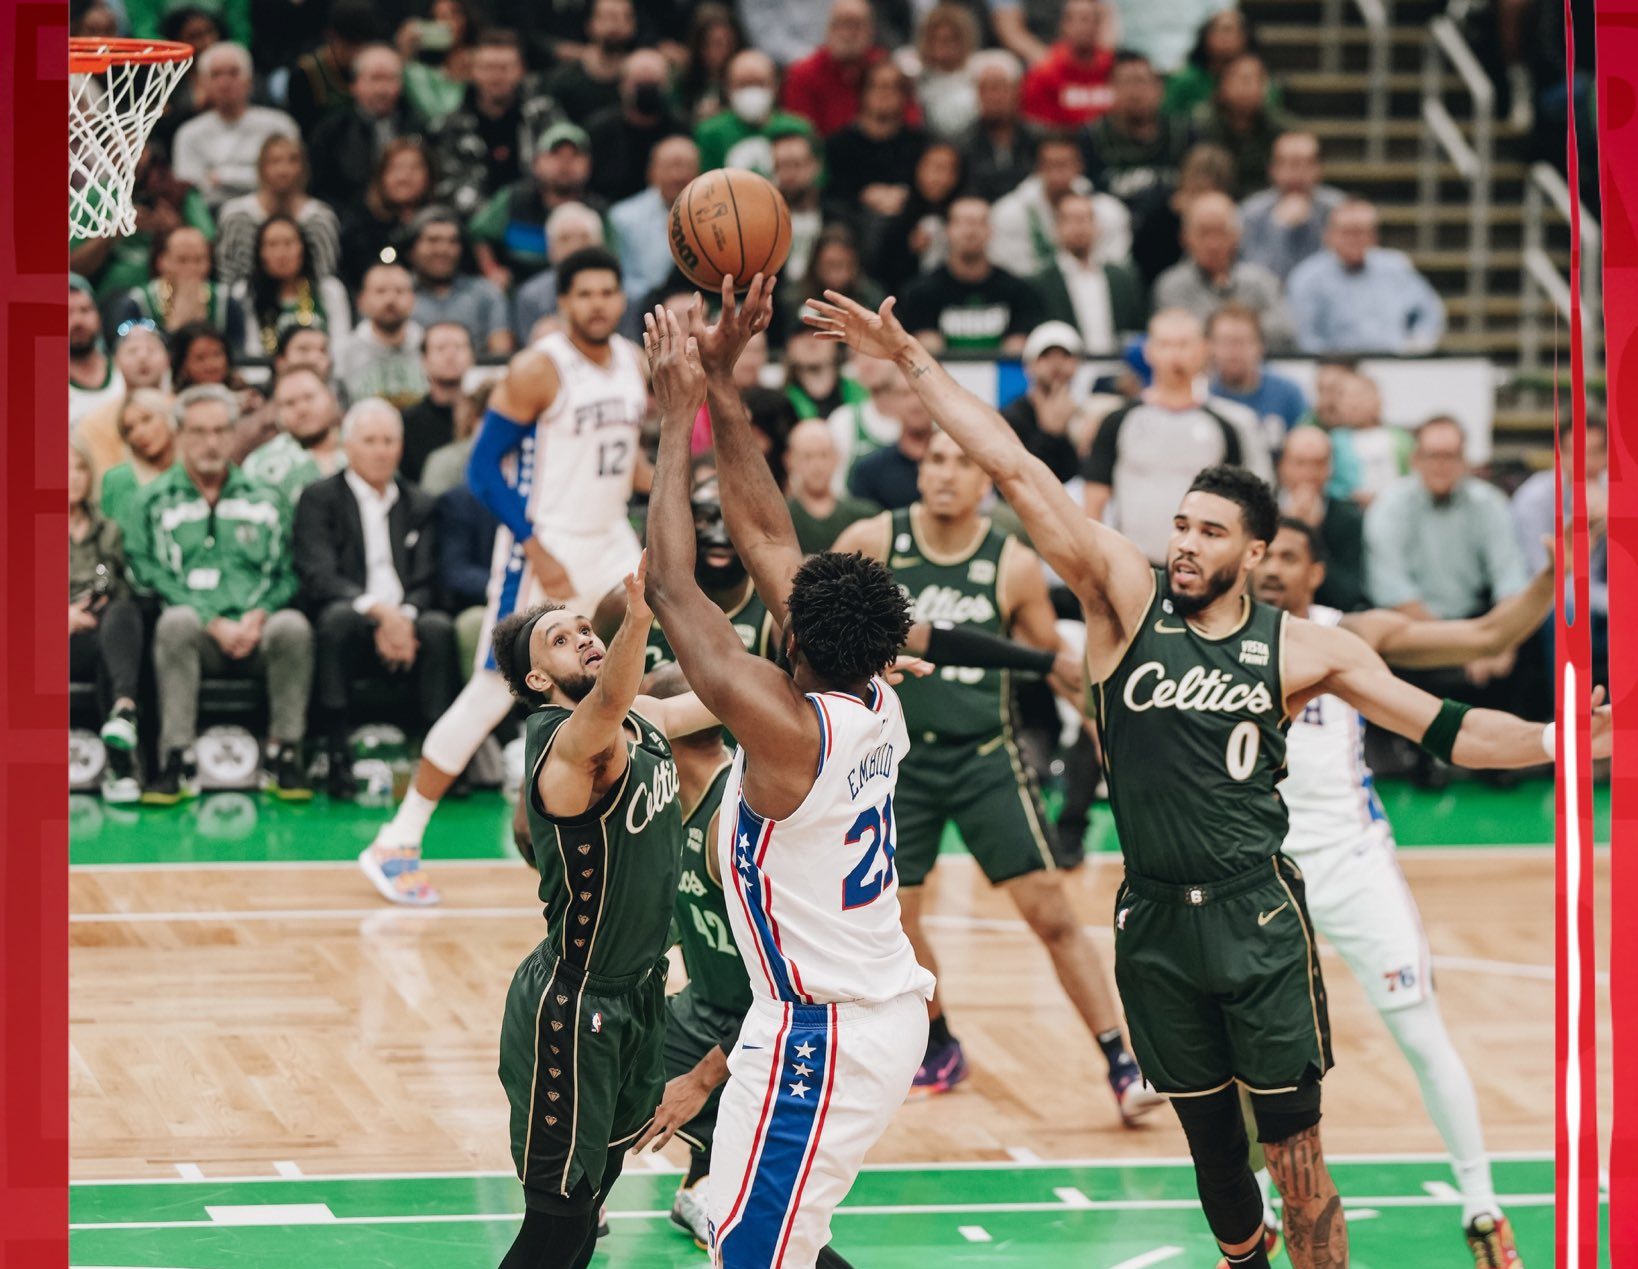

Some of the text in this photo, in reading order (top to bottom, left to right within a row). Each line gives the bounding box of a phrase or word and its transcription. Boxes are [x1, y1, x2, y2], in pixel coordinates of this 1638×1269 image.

[598, 439, 629, 477] 12
[1123, 661, 1273, 714] Celtics
[1226, 720, 1260, 781] 0
[841, 792, 895, 911] 21
[689, 902, 738, 957] 42
